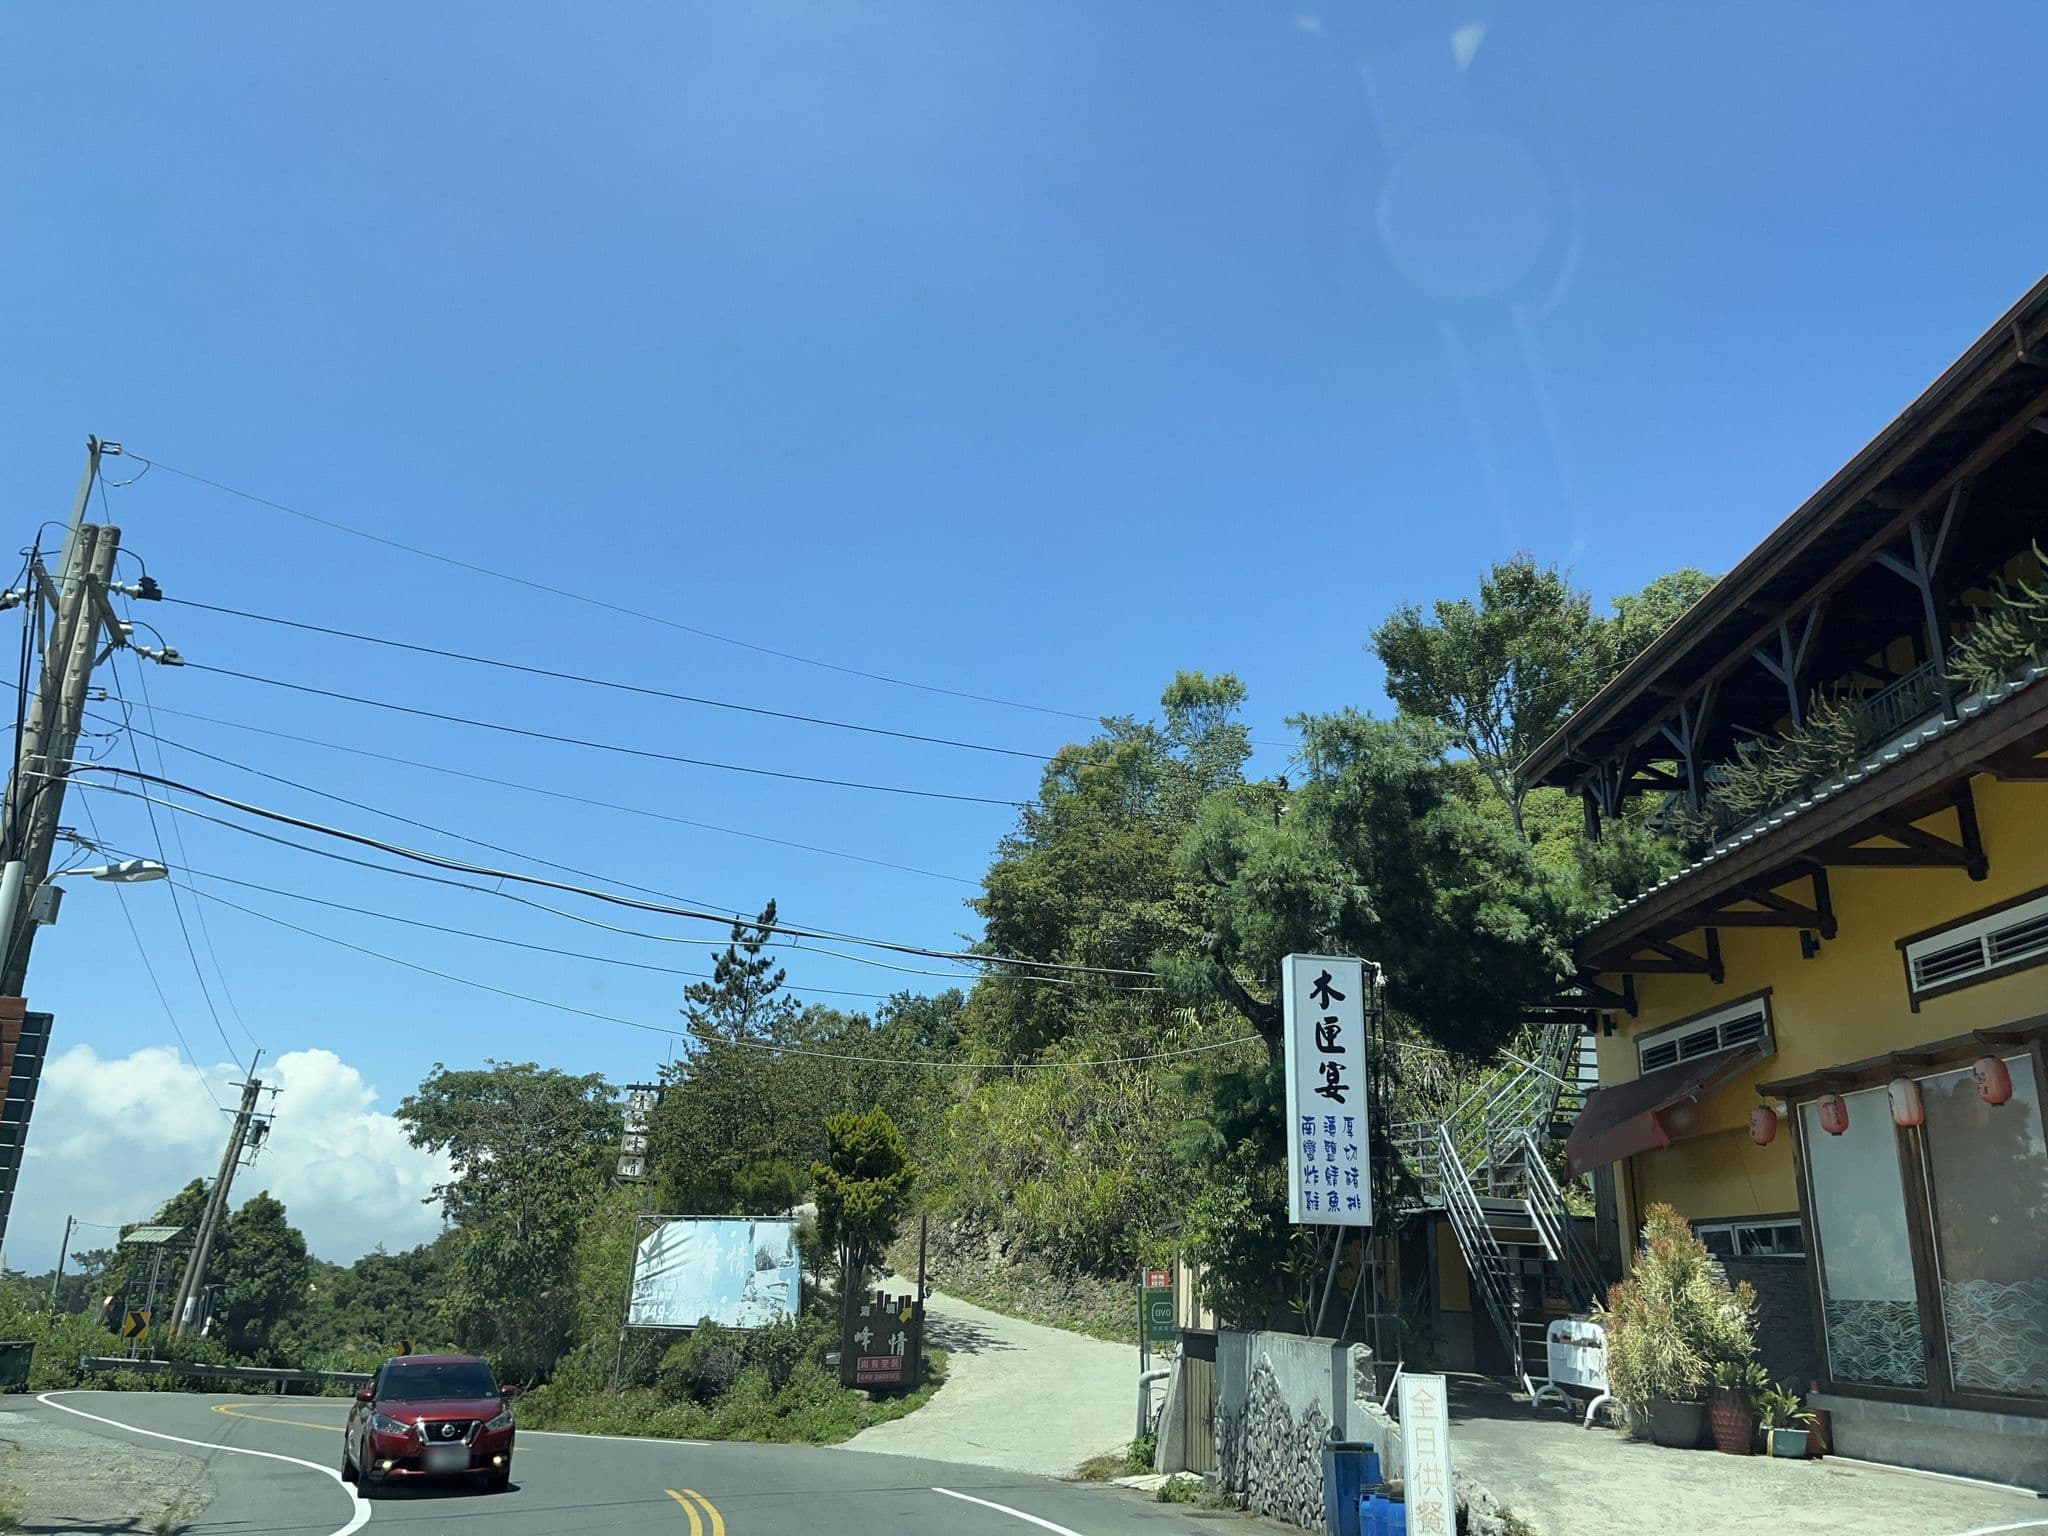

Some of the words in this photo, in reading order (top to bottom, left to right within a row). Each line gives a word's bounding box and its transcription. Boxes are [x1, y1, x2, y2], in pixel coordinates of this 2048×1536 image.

[1309, 969, 1350, 1104] 木匣宴
[1342, 1116, 1361, 1211] 厚切豬排
[1409, 1388, 1447, 1535] 全日供餐
